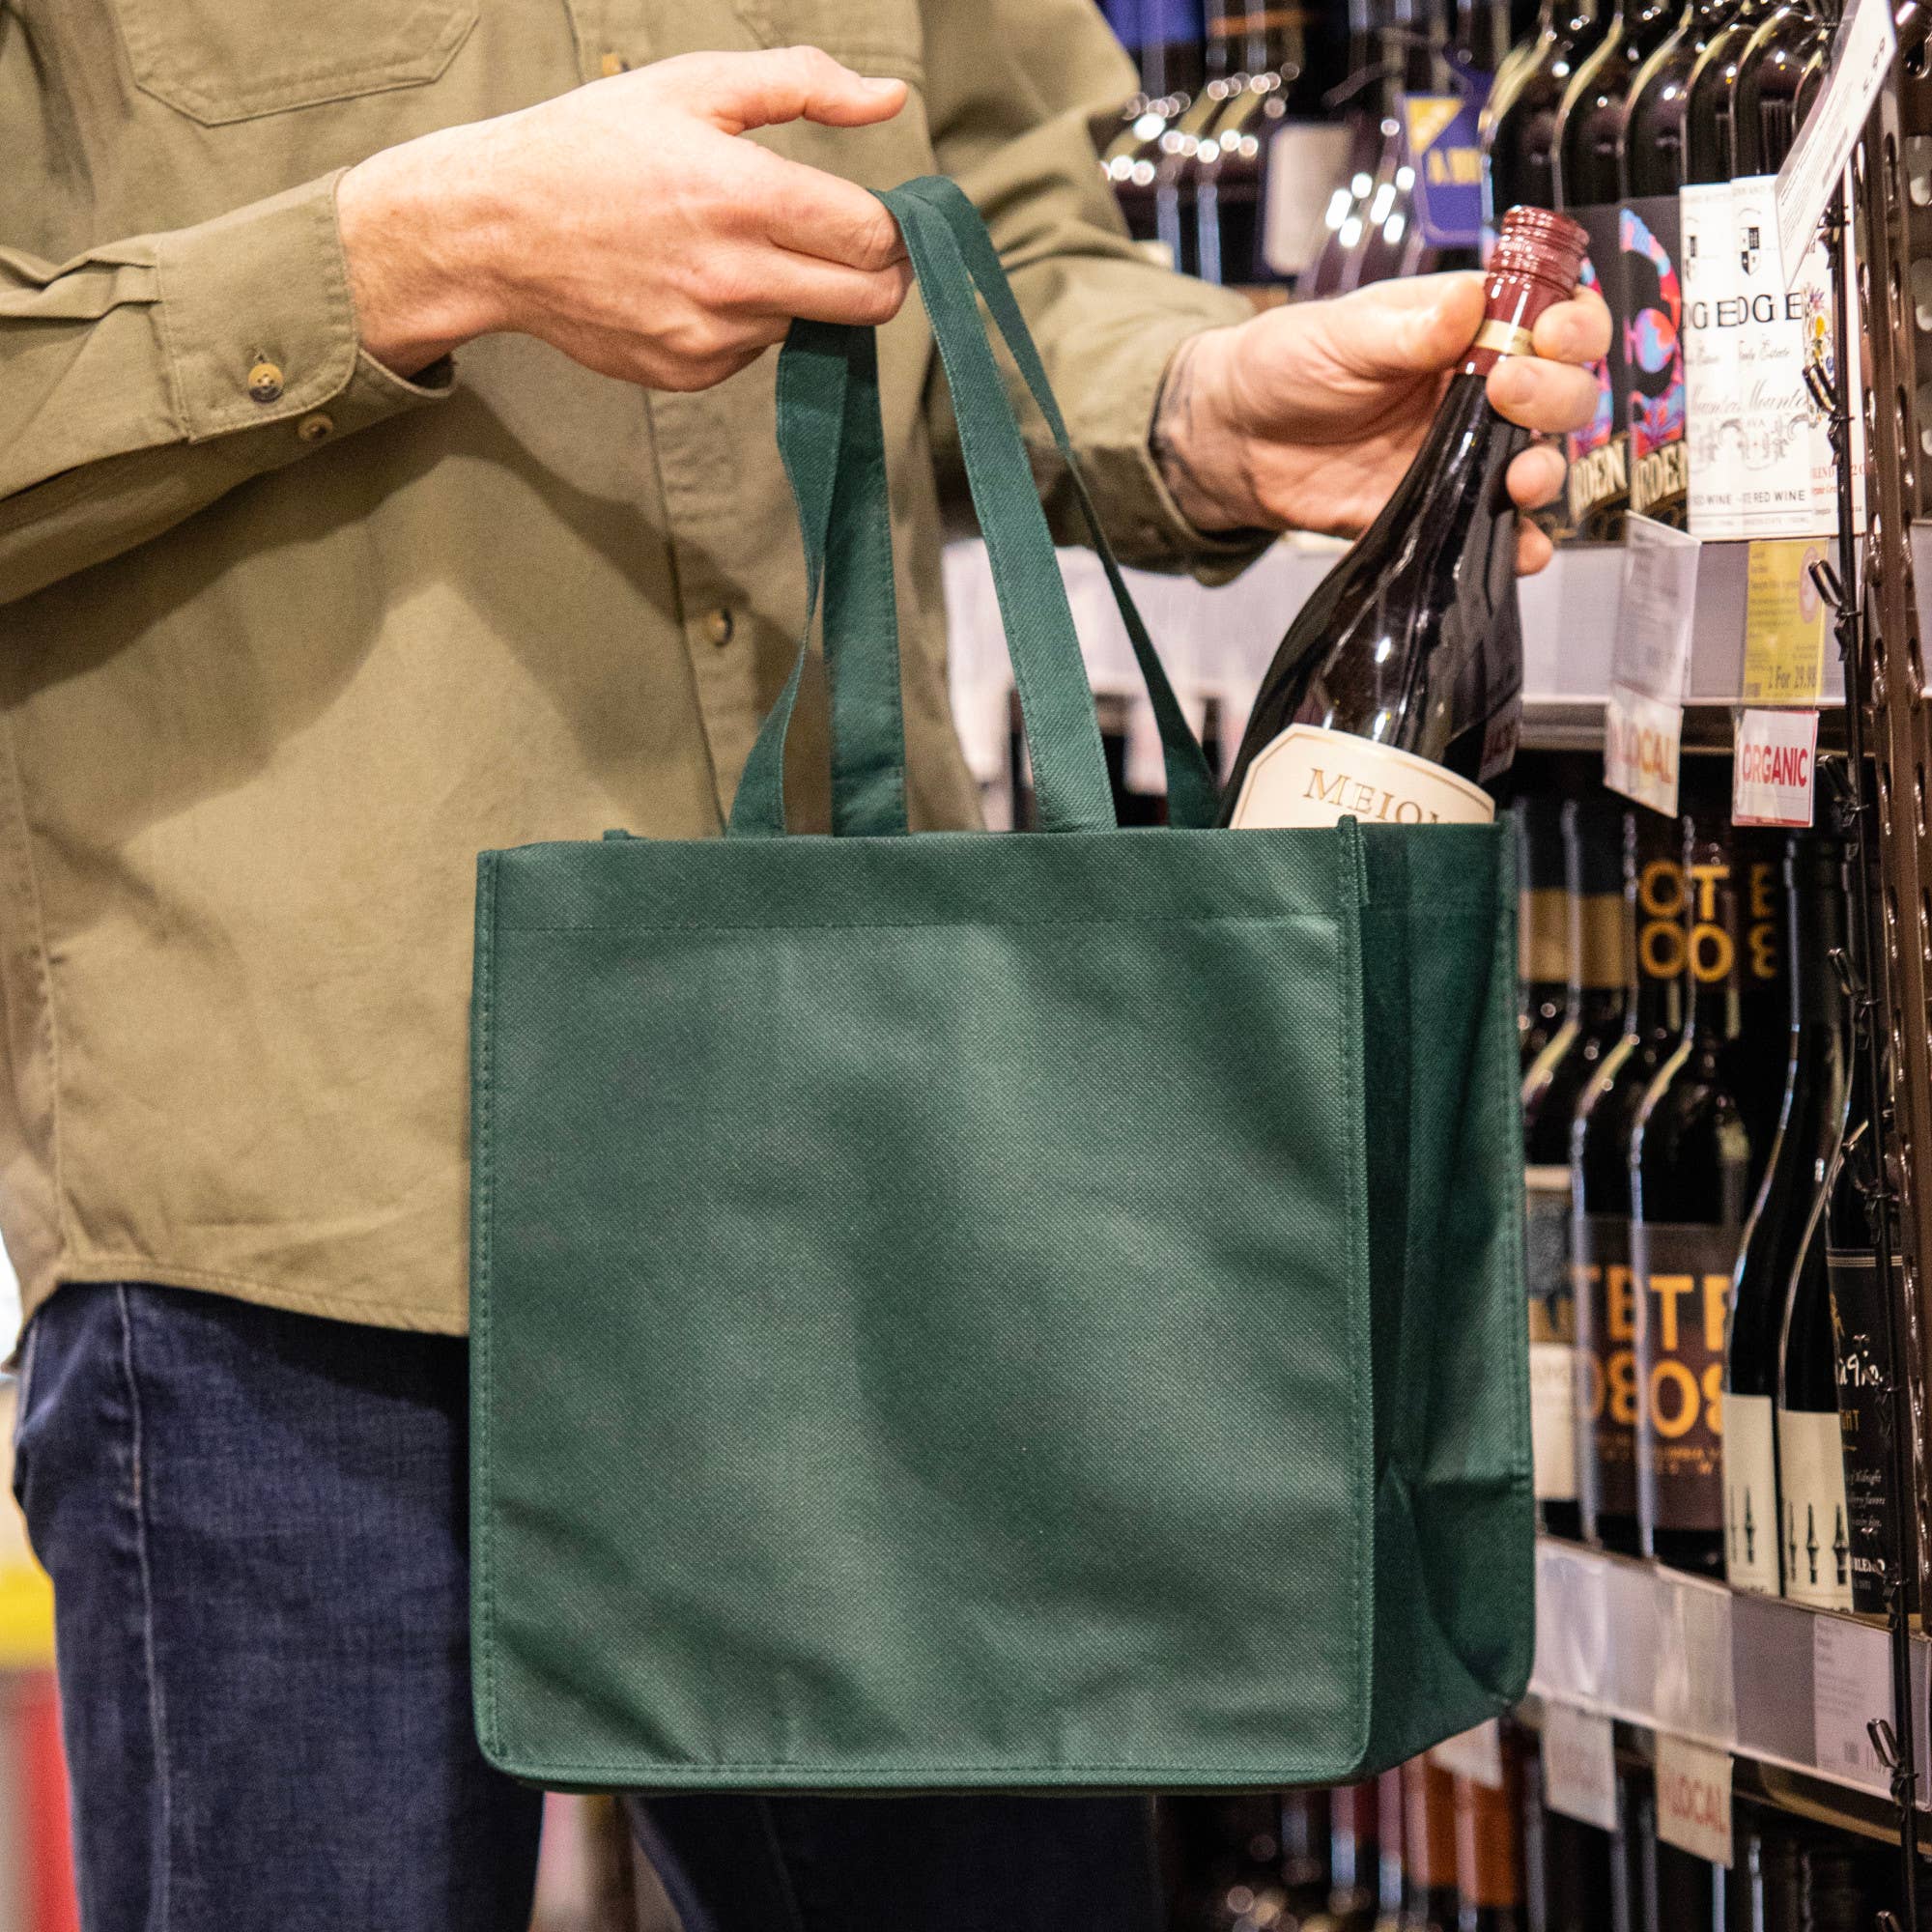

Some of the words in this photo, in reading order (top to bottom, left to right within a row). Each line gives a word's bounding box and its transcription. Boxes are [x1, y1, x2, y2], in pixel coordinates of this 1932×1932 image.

[1707, 494, 1732, 505] WINE
[1753, 491, 1771, 503] RED
[1775, 490, 1805, 502] WINE
[1742, 743, 1807, 787] ORGANIC
[1303, 767, 1447, 824] MEIO
